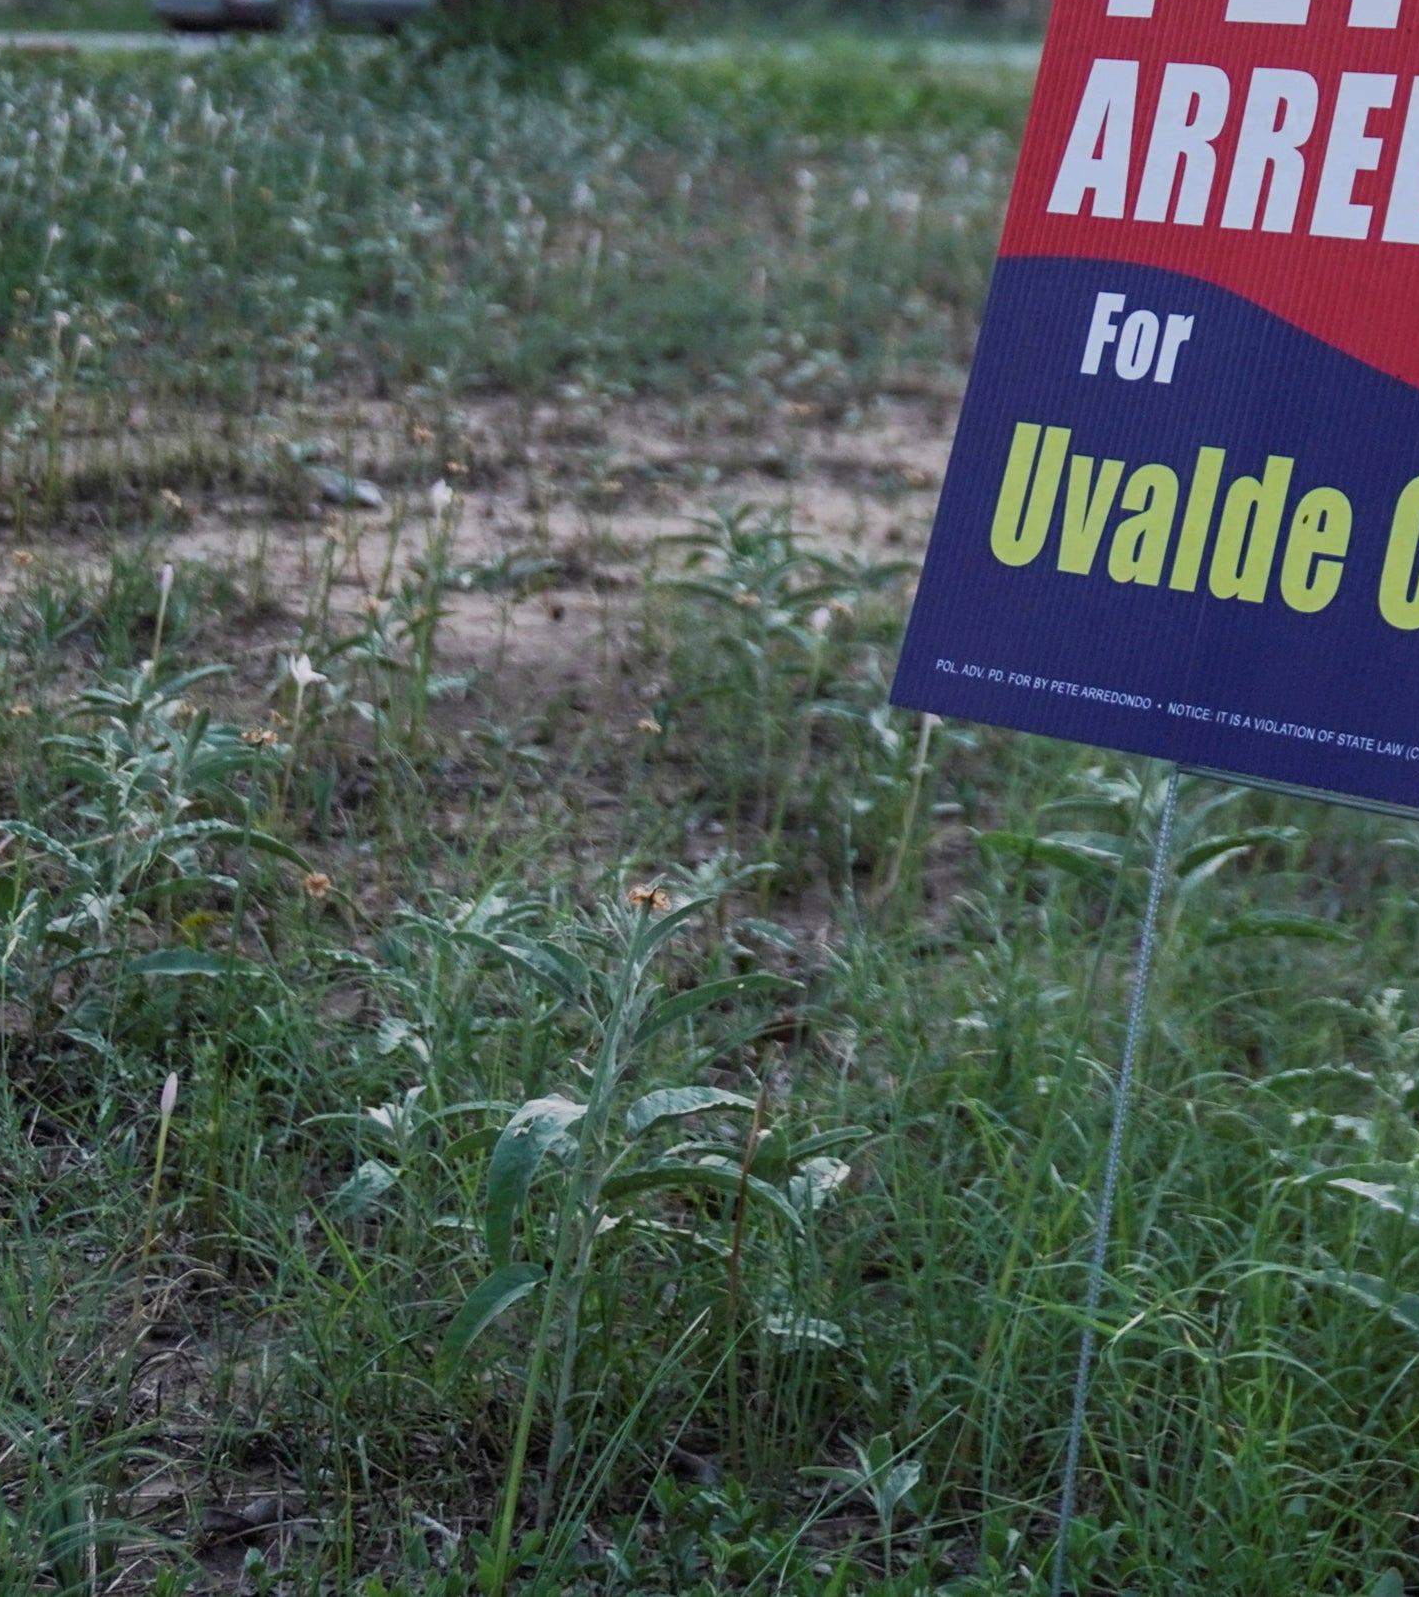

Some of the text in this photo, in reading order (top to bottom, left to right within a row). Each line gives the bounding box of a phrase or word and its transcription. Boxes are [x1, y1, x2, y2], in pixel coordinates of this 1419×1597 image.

[1079, 291, 1195, 385] For
[990, 421, 1353, 613] Uvalde
[936, 659, 959, 674] POL.
[961, 664, 985, 678] ADV.
[988, 669, 1005, 682] PD.
[1008, 672, 1031, 687] FOR
[1033, 677, 1049, 689] BY
[1050, 680, 1080, 696] PETE
[1080, 686, 1152, 709] ARREDONDO
[1167, 702, 1213, 721] NOTICE:
[1216, 711, 1228, 723] IT
[1229, 714, 1241, 726] IS
[1242, 716, 1251, 728] A
[1254, 718, 1316, 740] VIOLATION
[1317, 730, 1335, 743] OF
[1337, 733, 1374, 751] STATE
[1377, 741, 1404, 756] LAW
